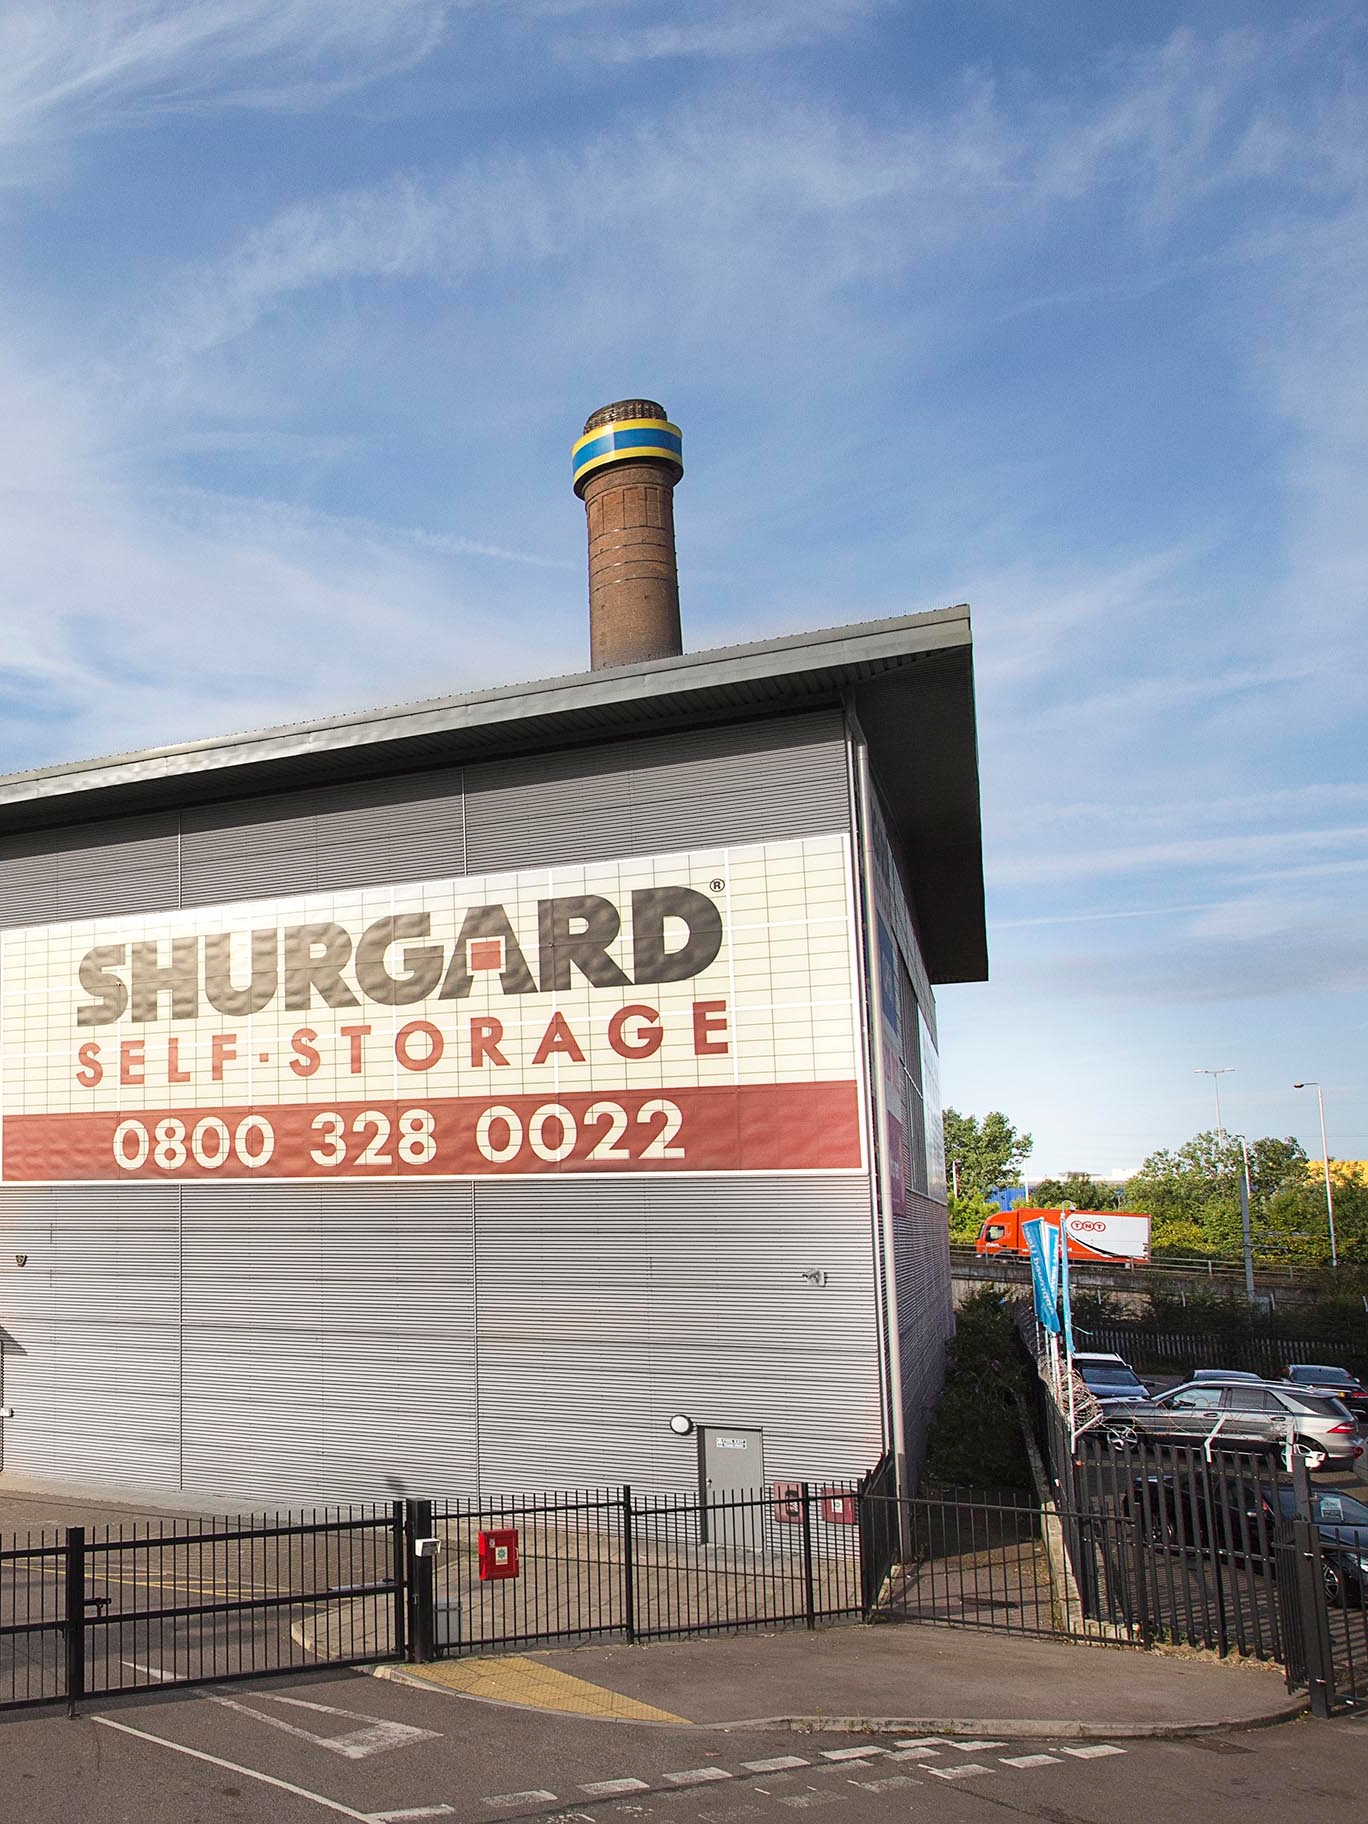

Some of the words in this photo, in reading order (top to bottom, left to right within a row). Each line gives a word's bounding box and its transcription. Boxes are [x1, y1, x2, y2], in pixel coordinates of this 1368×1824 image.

[77, 886, 722, 1027] SHURGARD
[113, 1115, 275, 1170] 0800
[310, 1108, 437, 1167] 328
[475, 1099, 686, 1162] 0022
[1071, 1220, 1106, 1232] TNT
